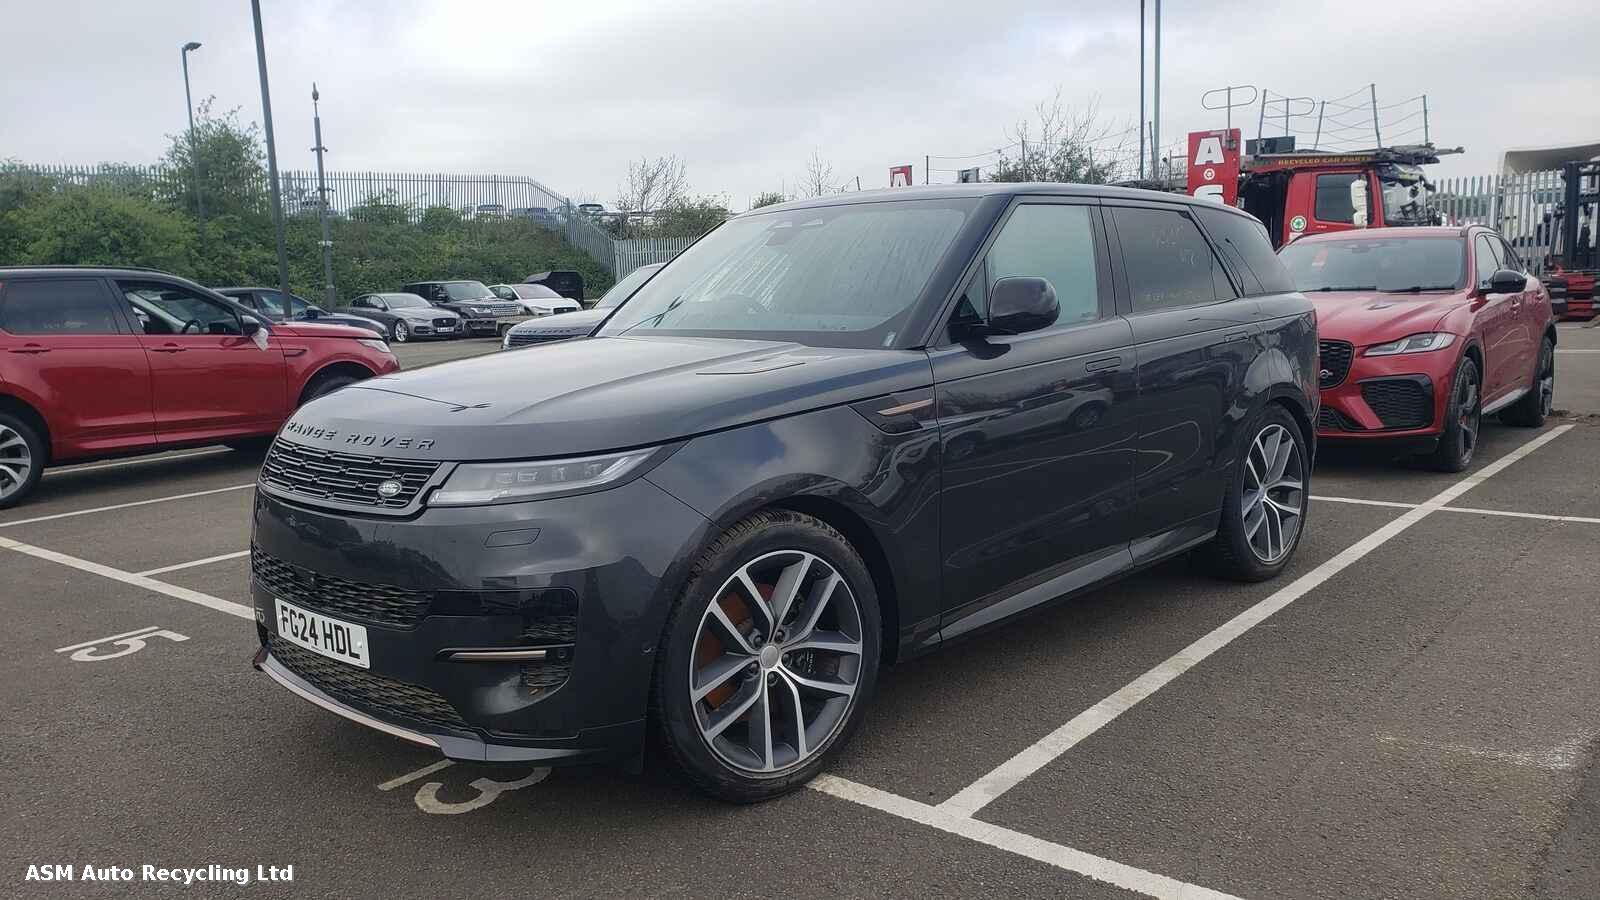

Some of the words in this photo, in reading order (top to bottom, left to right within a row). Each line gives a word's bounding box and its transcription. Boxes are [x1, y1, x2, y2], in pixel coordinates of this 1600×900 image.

[1194, 136, 1225, 166] A
[287, 421, 337, 441] RANGE
[345, 433, 436, 450] ROVER
[280, 604, 319, 646] FG24
[321, 620, 361, 660] HDL
